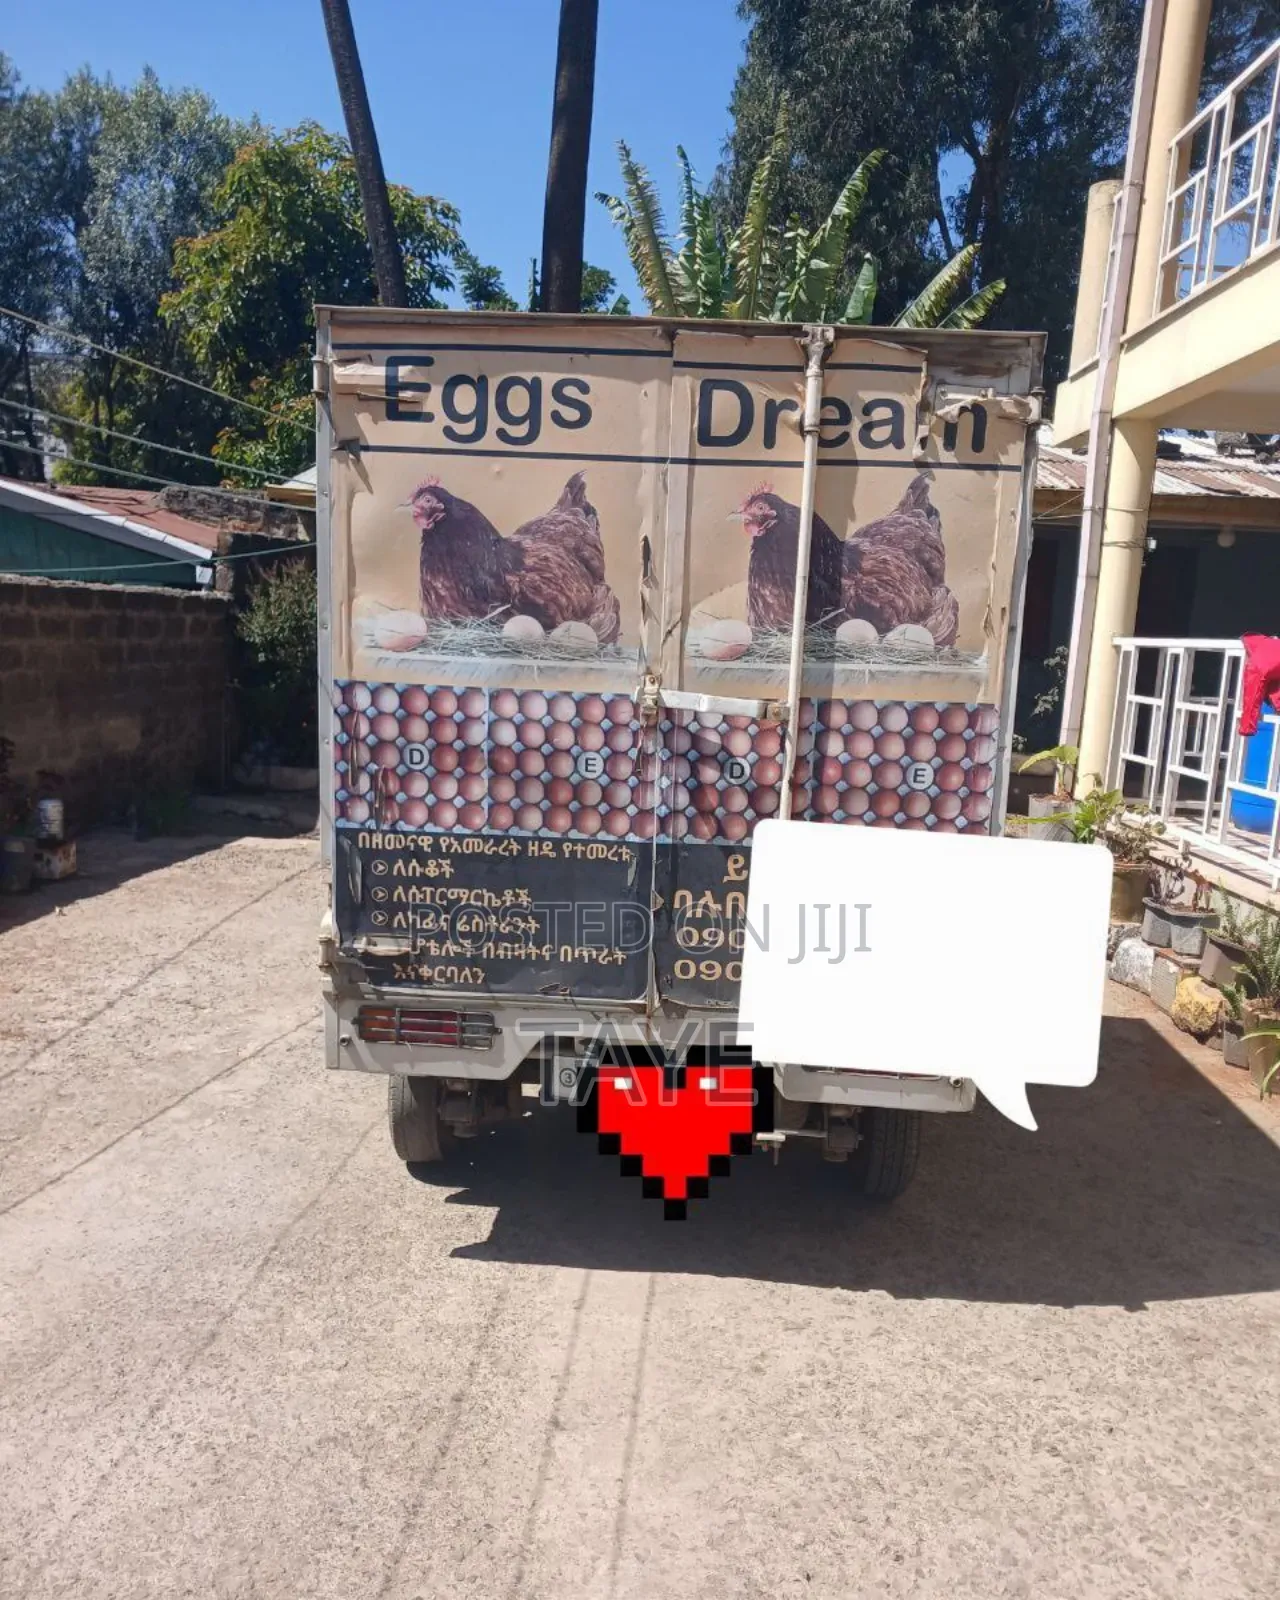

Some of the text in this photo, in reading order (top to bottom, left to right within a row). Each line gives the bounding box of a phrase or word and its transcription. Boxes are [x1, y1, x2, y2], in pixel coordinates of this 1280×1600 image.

[385, 355, 592, 446] Eggs
[408, 748, 597, 773] D E
[729, 762, 927, 784] D E
[358, 832, 433, 853] በዘመናዊ
[439, 836, 521, 856] የአመራረት
[393, 858, 454, 879] ለሱቆች
[393, 885, 532, 907] ለሱፐርማርኬቶች
